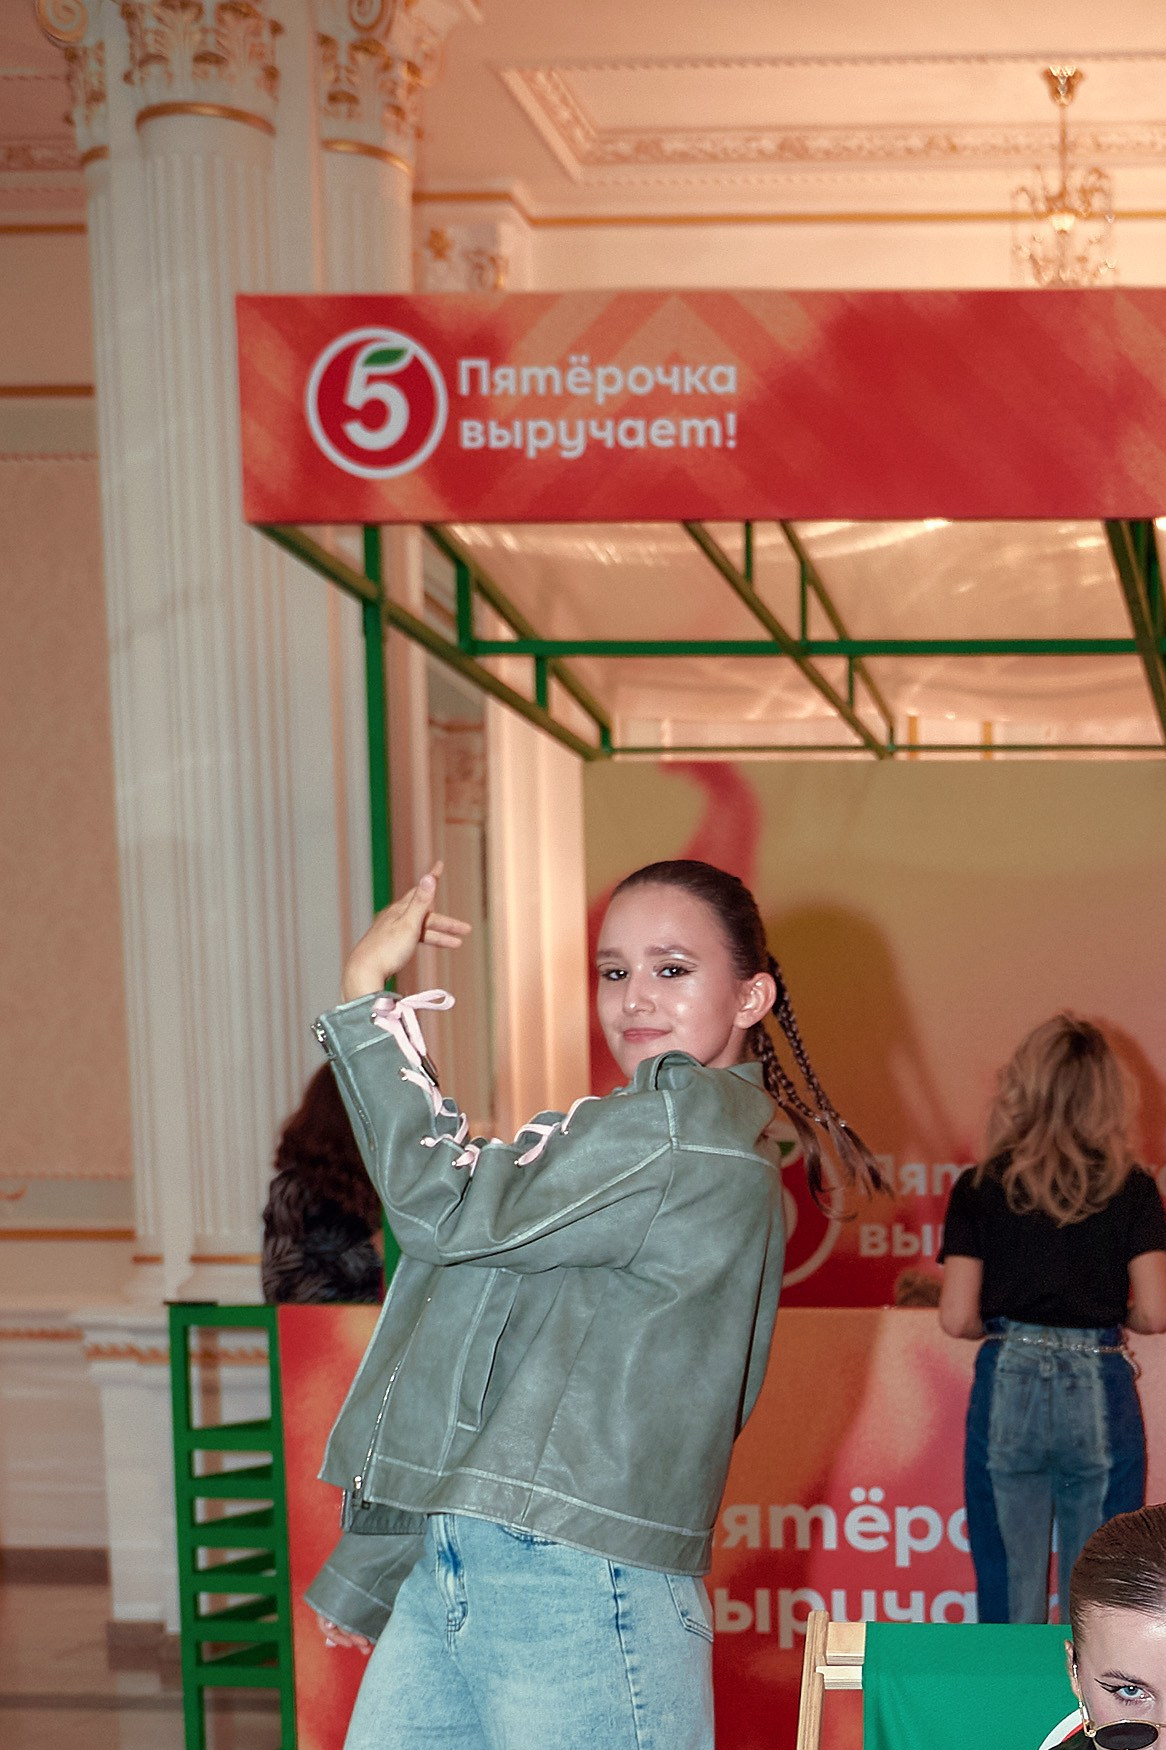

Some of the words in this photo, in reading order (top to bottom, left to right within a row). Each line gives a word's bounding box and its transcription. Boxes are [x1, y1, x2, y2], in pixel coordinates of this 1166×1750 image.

[342, 336, 414, 450] 5
[458, 355, 738, 404] Пятёрочка
[459, 411, 738, 460] выручает!
